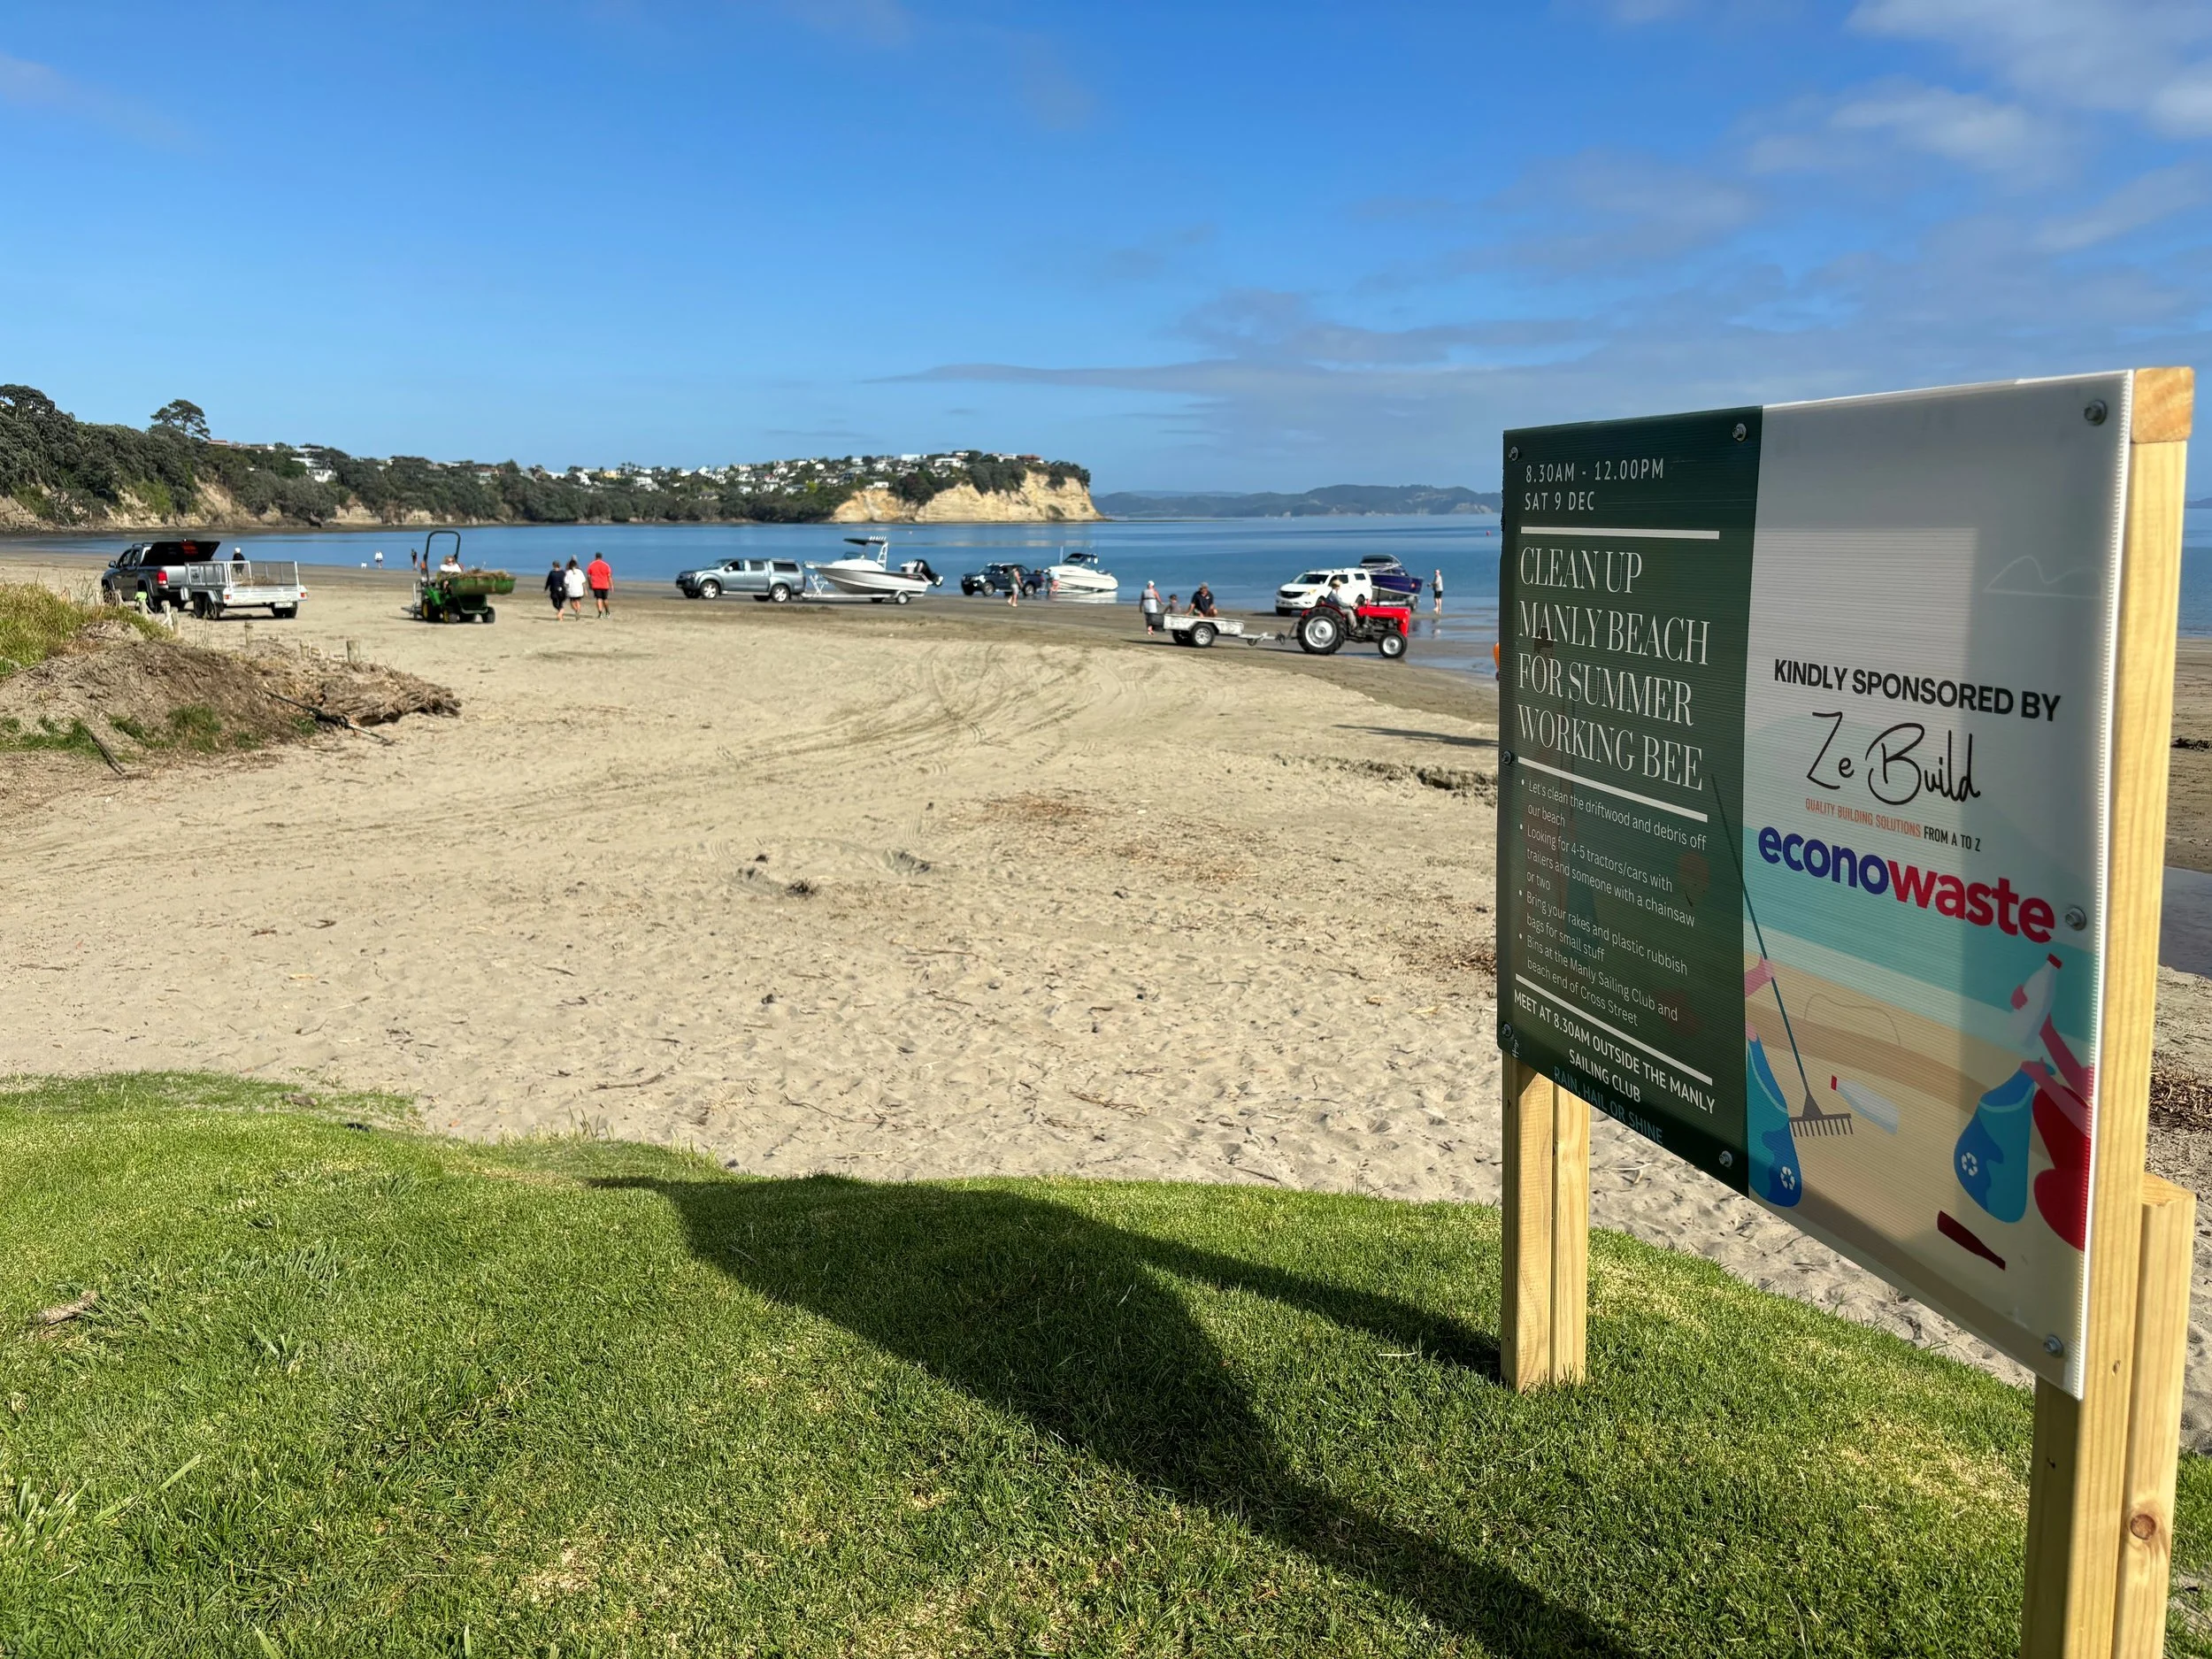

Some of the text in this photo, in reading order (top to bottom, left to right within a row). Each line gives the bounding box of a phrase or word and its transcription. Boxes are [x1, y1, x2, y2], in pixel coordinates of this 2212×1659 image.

[1525, 463, 1575, 483] 8.30AM
[1594, 457, 1663, 480] 12.00PM
[1525, 491, 1594, 511] SAT 9 DEC
[1520, 547, 1642, 594] CLEAN UP
[1518, 600, 1710, 665] MANLY BEACH
[1518, 652, 1694, 726] FOR SUMMER
[1774, 658, 2061, 721] KINDLY SPONSORED BY
[1517, 704, 1702, 791] WORKING BEE
[1807, 711, 1981, 805] Ze Build
[1528, 780, 1707, 850] Let's clean the driftwood and debris off
[1528, 805, 1565, 826] our beach
[1805, 798, 1981, 851] QUALITY BUILDING SOLUTIONS FROM A TO Z
[1527, 825, 1672, 893] Looking for 4-5 tractors/cars with
[1527, 872, 1550, 890] or two
[1527, 849, 1695, 927] trailers and someone with a chainsaw
[1758, 826, 2055, 943] econowaste
[1526, 891, 1687, 976] Bring your rakes and plastic rubbish
[1526, 913, 1604, 962] bags for small stuff
[1527, 935, 1678, 1021] Bins at the Manly Sailing Club and
[1527, 956, 1638, 1026] beach end of Cross Street
[1515, 989, 1715, 1115] MEET AT 8.30AM OUTSIDE THE MANLY
[1570, 1048, 1641, 1102] SAILING CLUB
[1554, 1065, 1663, 1144] RAIN, HAIL OR SHINE
